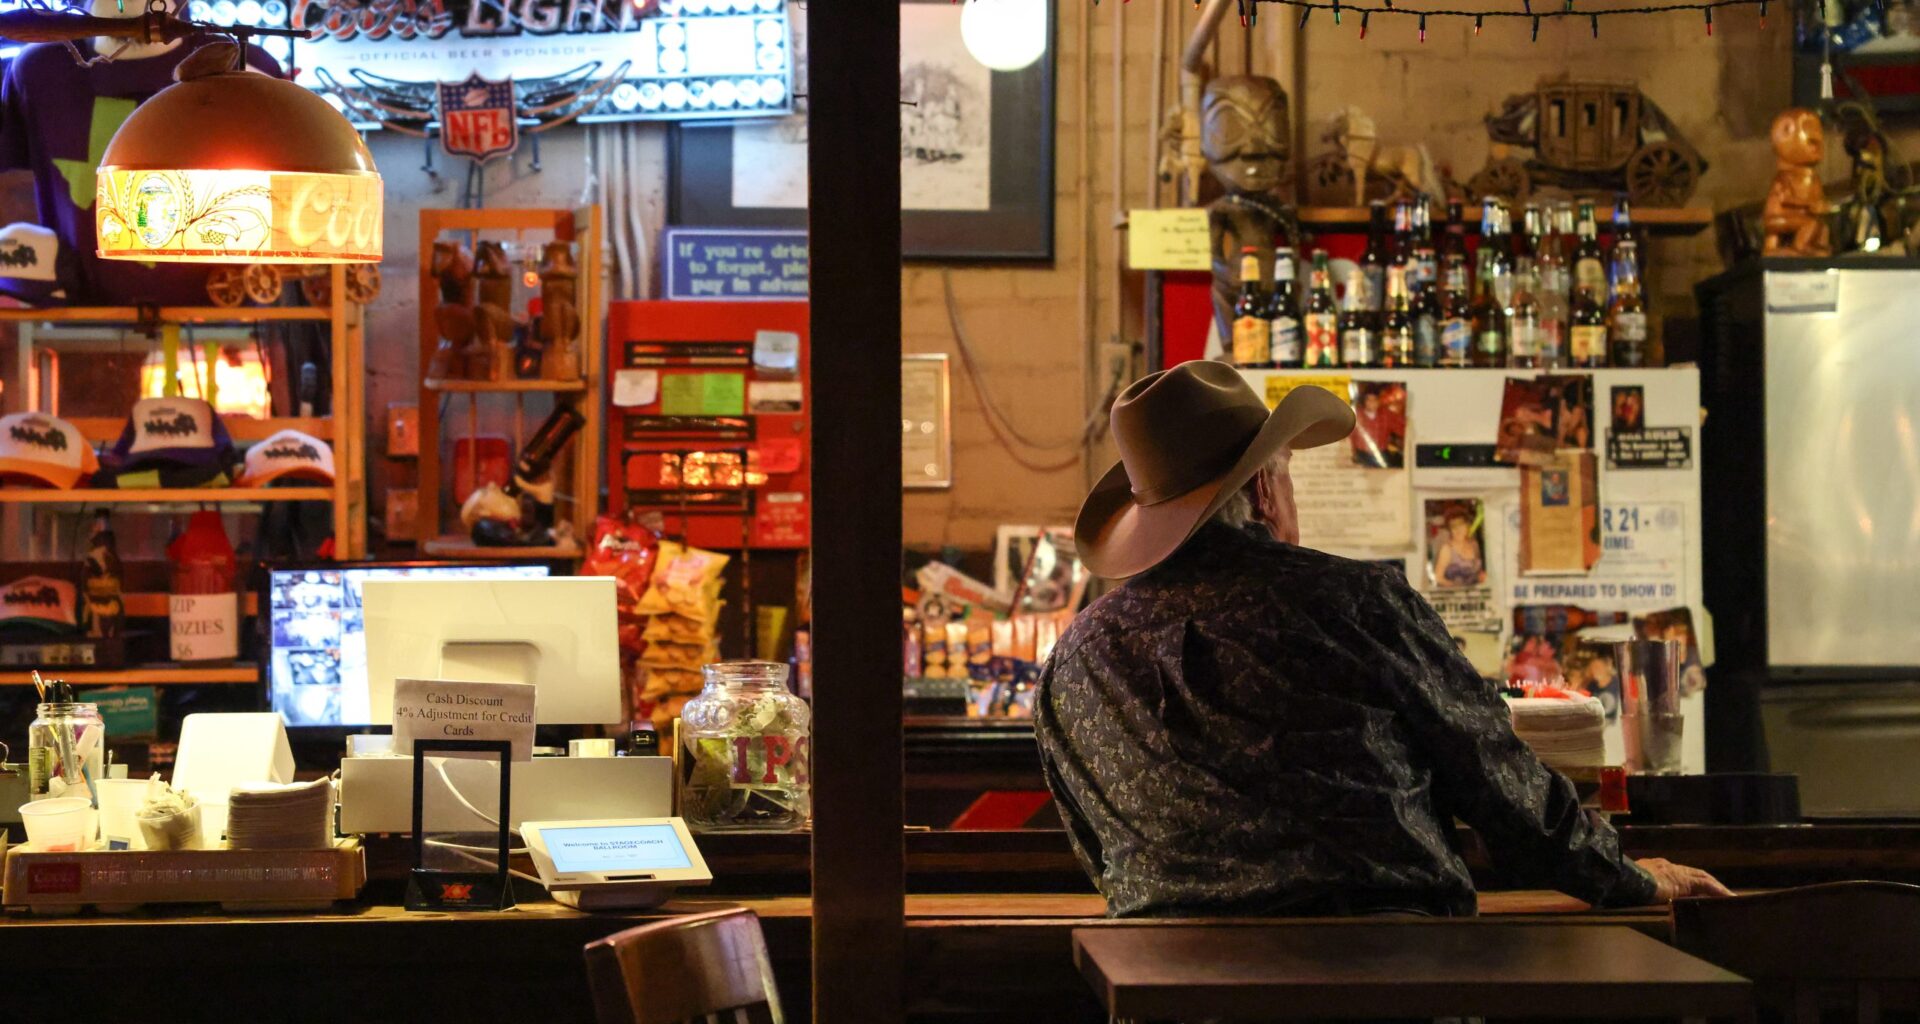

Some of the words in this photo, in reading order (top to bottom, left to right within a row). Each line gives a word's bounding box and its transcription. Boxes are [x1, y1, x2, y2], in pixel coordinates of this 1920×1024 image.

[359, 51, 437, 63] OFFICIAL
[447, 48, 493, 60] BEER
[501, 46, 587, 58] SPONSOR
[447, 110, 510, 153] NFL
[679, 242, 695, 258] If
[689, 260, 707, 275] to
[782, 260, 808, 278] ple
[691, 279, 724, 295] pay
[732, 277, 750, 293] in
[759, 277, 808, 293] advan
[1618, 507, 1639, 532] 21
[1513, 584, 1528, 598] BE
[1533, 584, 1597, 599] PREPARED
[1599, 584, 1617, 598] TO
[1620, 584, 1656, 598] SHOW
[426, 692, 453, 705] Cash
[456, 694, 503, 707] Discount
[396, 706, 414, 719] 4%
[416, 708, 478, 722] Adjustment
[481, 710, 498, 722] for
[499, 711, 532, 724] Credit
[443, 724, 474, 736] Cards
